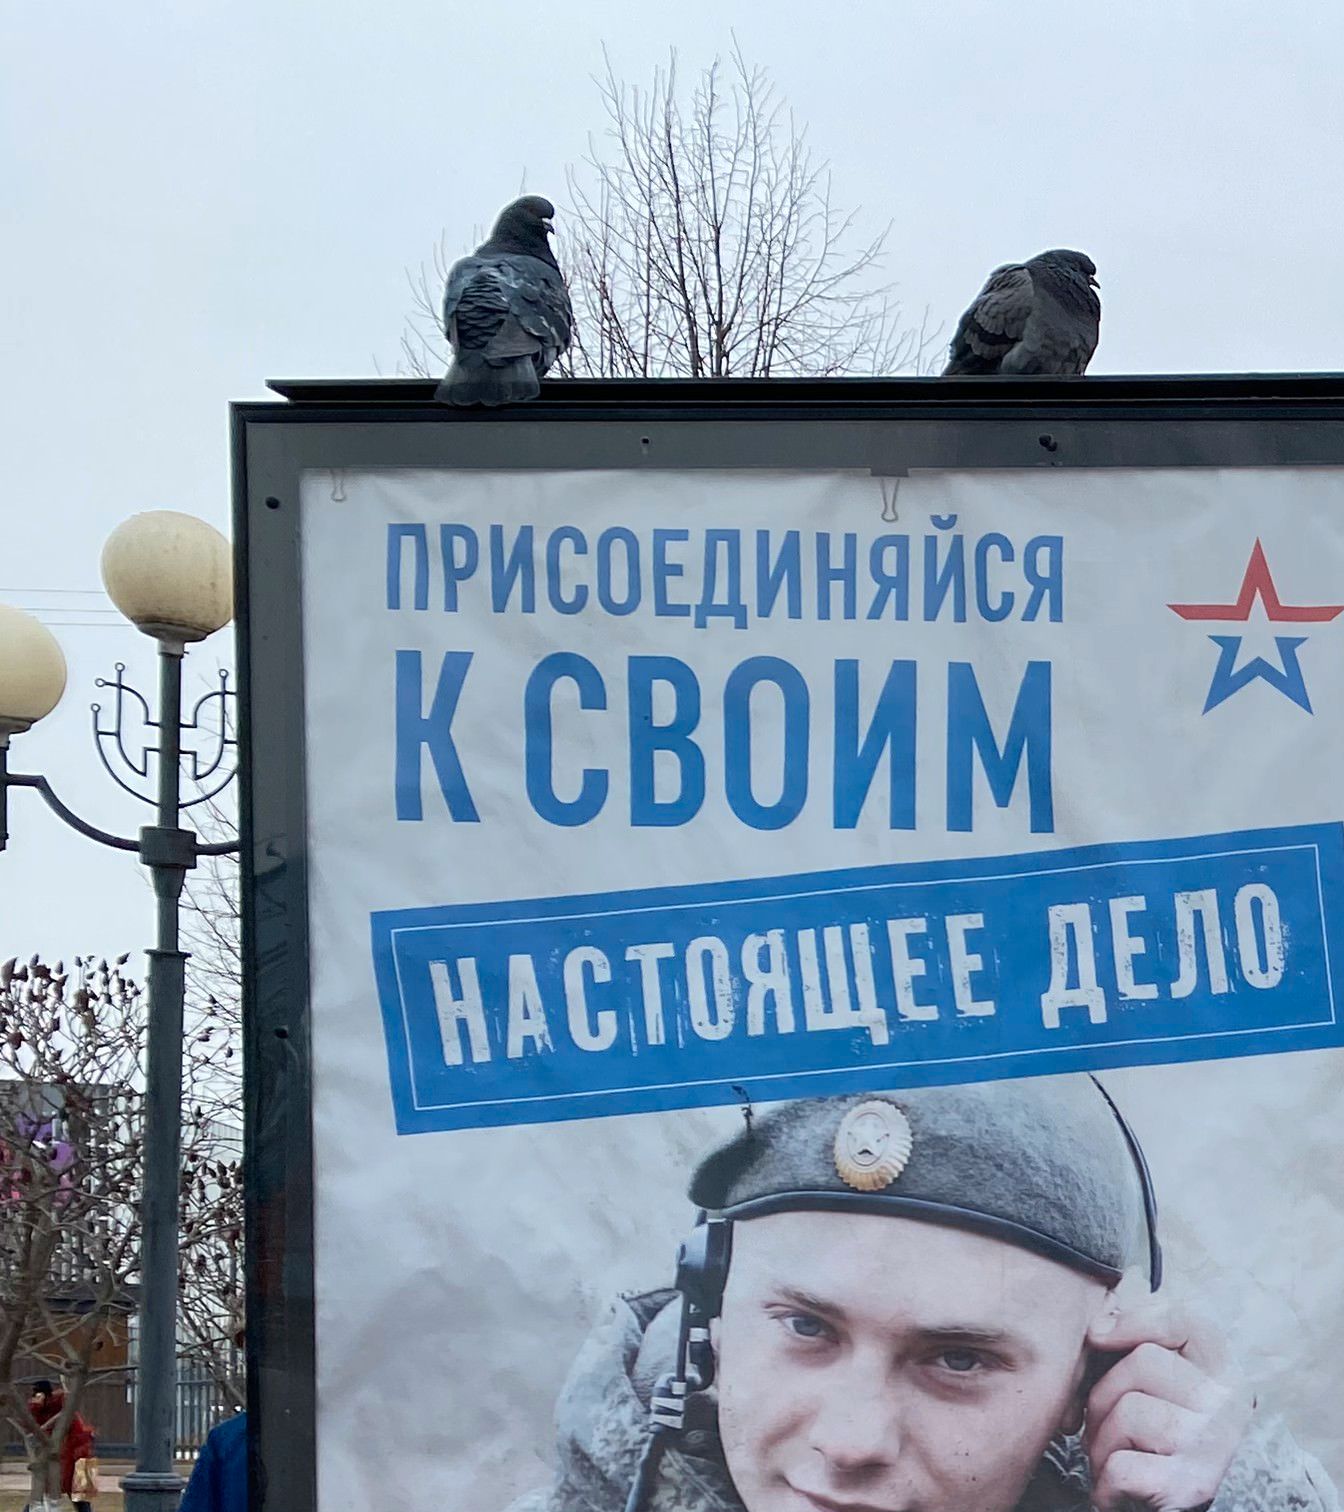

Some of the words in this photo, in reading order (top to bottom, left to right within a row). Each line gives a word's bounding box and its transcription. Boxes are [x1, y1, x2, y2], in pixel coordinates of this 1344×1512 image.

[385, 513, 1066, 632] ПРИСОЕДИНЯЙСЯ
[393, 648, 482, 826] К
[521, 650, 1057, 836] СВОИМ
[429, 911, 997, 1067] НАСТОЯЩЕЕ
[1040, 882, 1285, 1030] ДЕЛО
